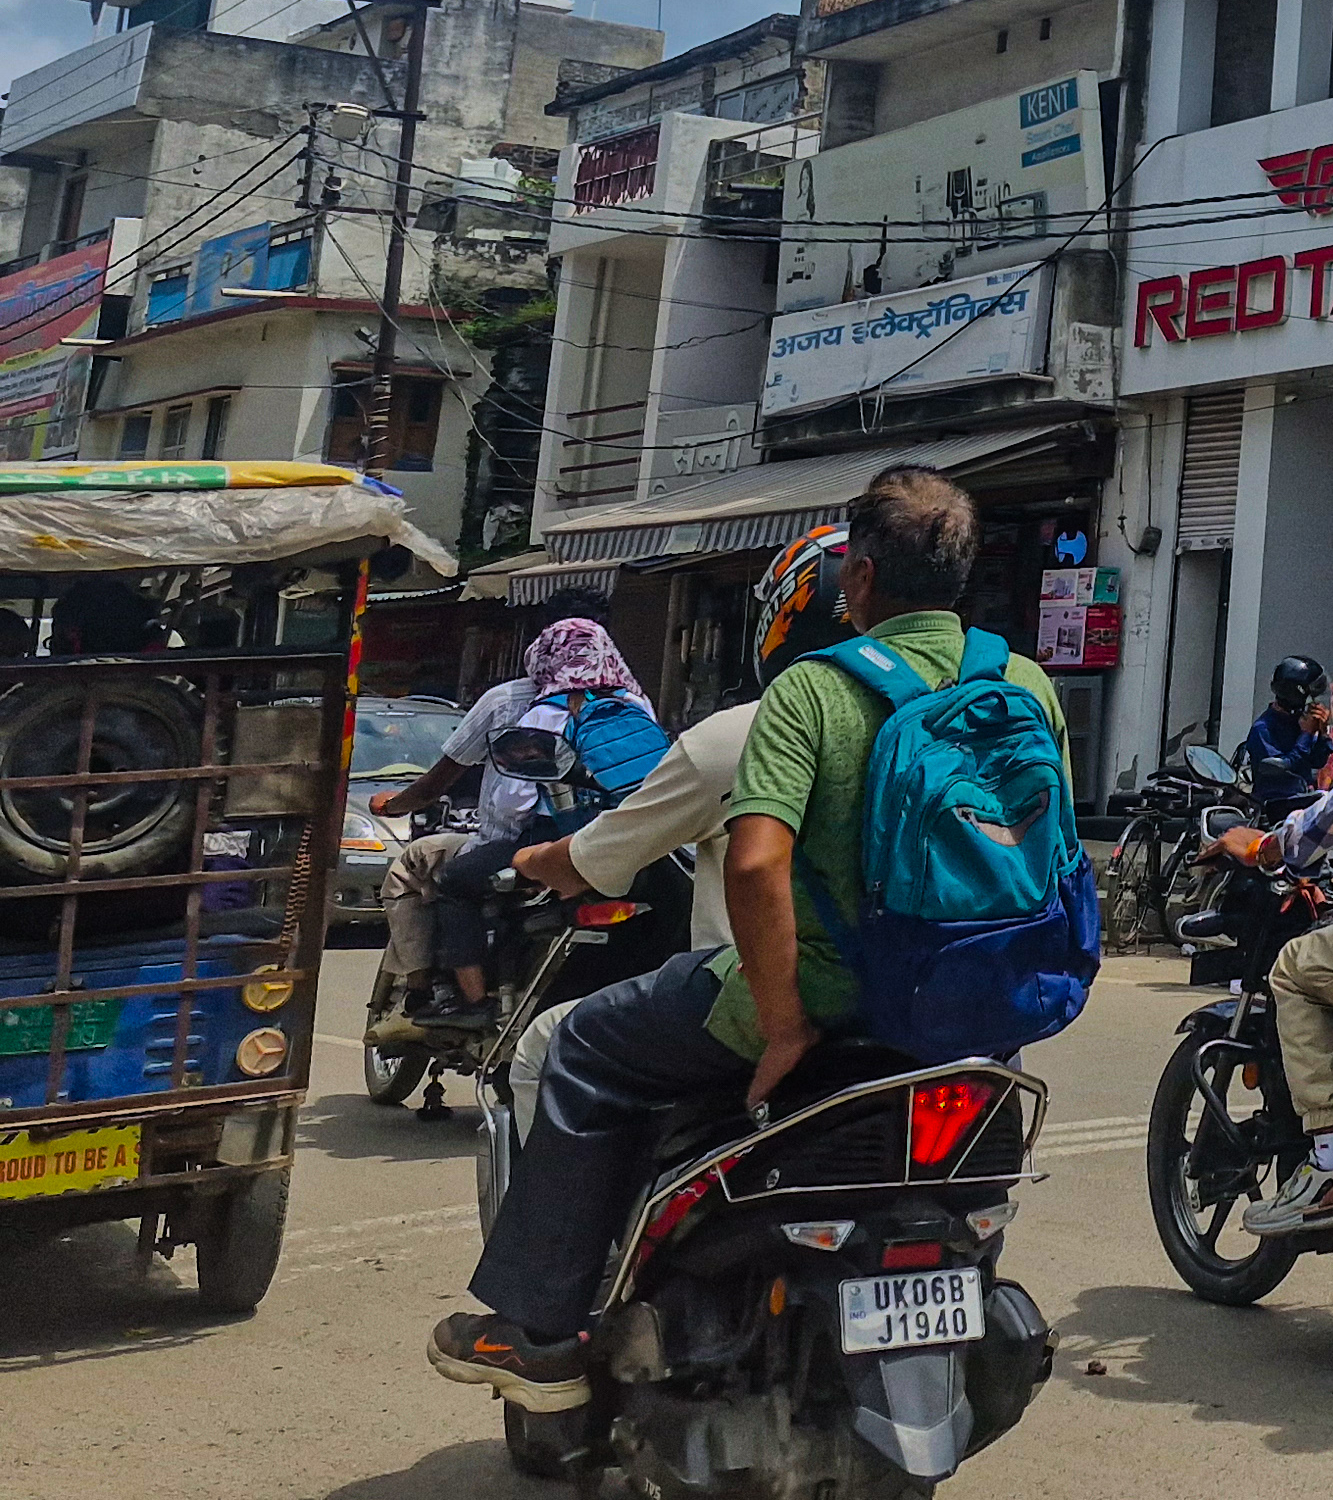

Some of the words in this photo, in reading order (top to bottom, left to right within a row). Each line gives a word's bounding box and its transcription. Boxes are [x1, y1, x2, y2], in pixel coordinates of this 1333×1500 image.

[1026, 82, 1070, 122] KENT
[771, 324, 846, 358] अजय
[53, 1150, 77, 1176] TO
[83, 1145, 109, 1172] BE
[113, 1143, 127, 1169] A
[873, 1274, 965, 1311] UK06B
[877, 1307, 968, 1345] J1940
